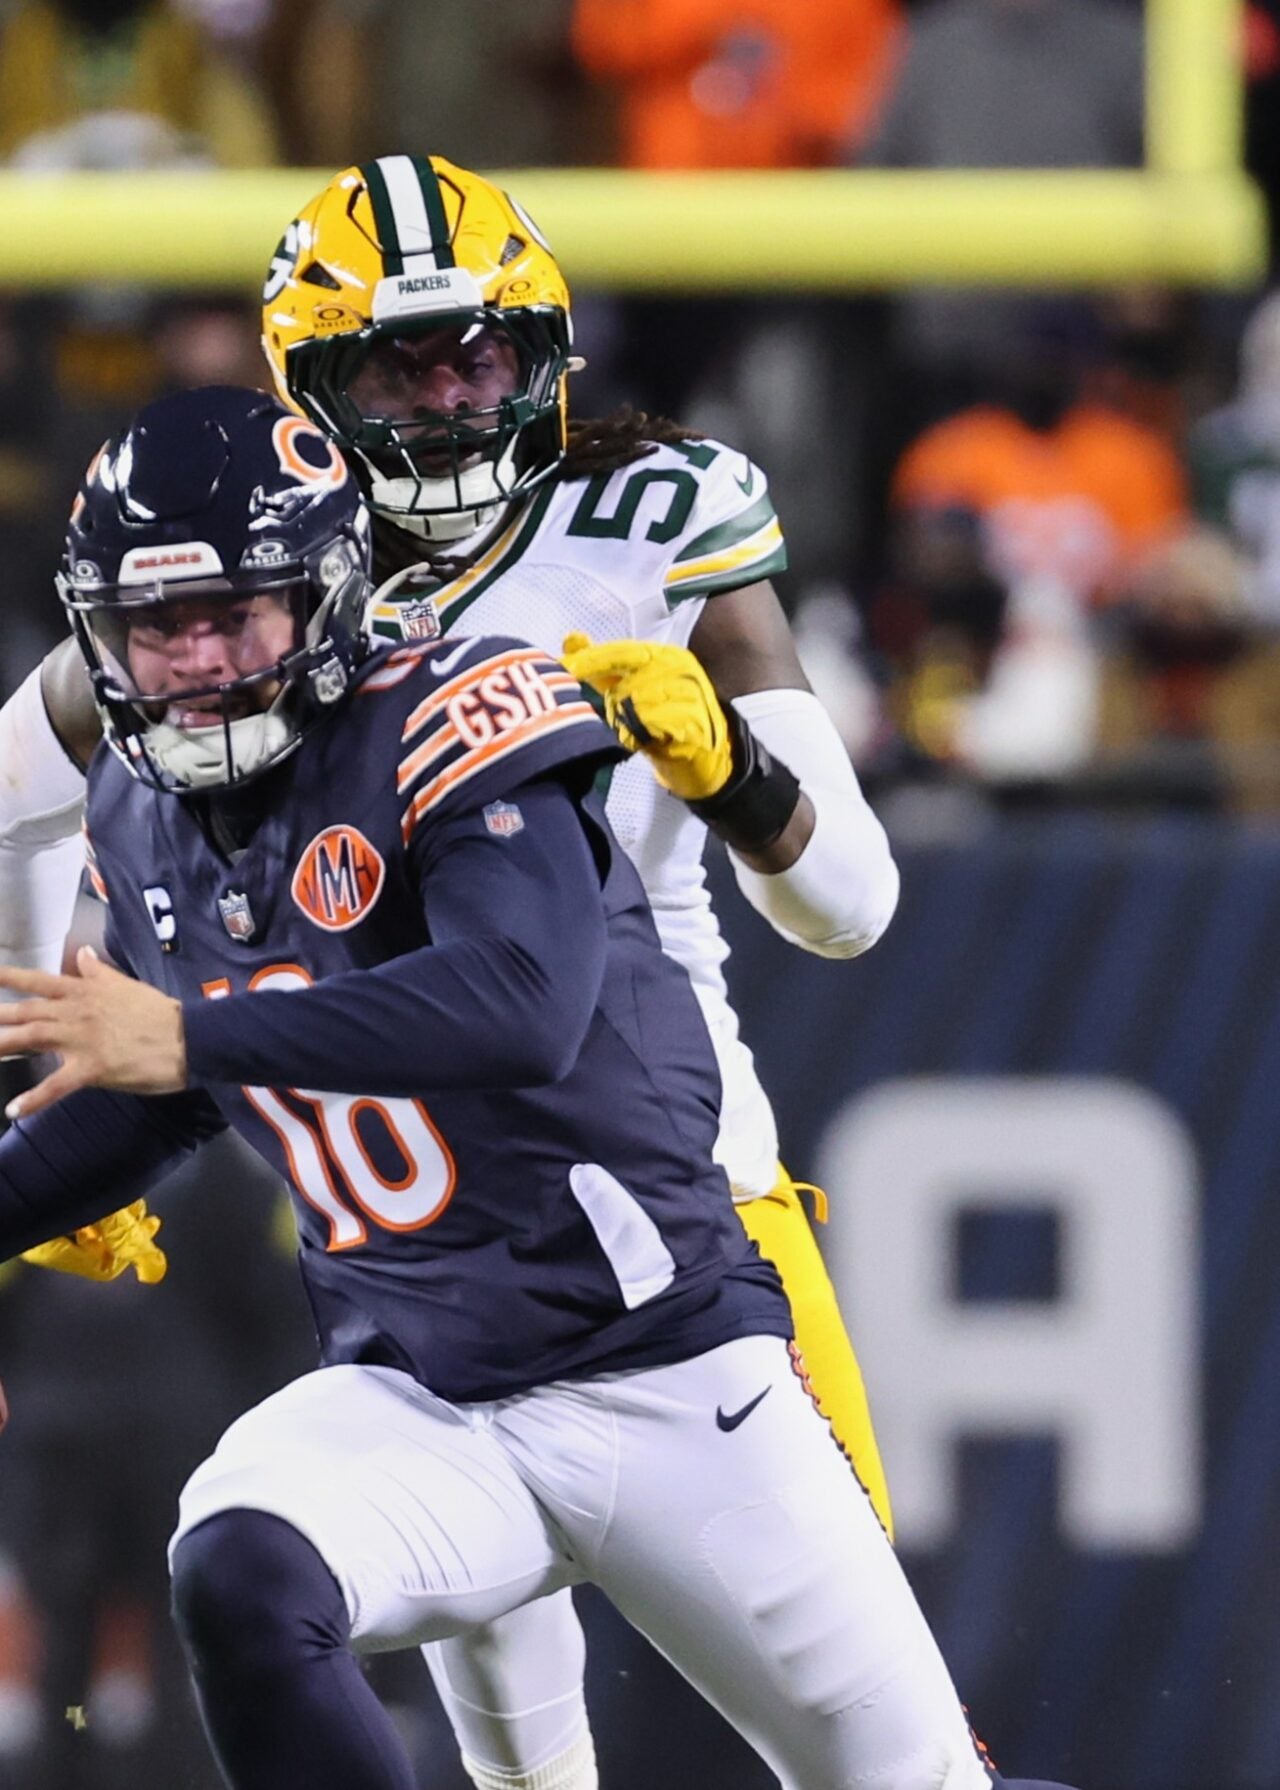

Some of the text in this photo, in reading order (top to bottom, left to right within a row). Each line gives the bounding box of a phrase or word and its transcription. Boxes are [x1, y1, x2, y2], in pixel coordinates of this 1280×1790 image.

[397, 274, 452, 296] PACKERS
[133, 551, 202, 570] BEARS
[447, 661, 558, 749] GSH
[490, 813, 517, 829] NFL
[143, 886, 176, 940] C
[825, 1075, 1204, 1555] A
